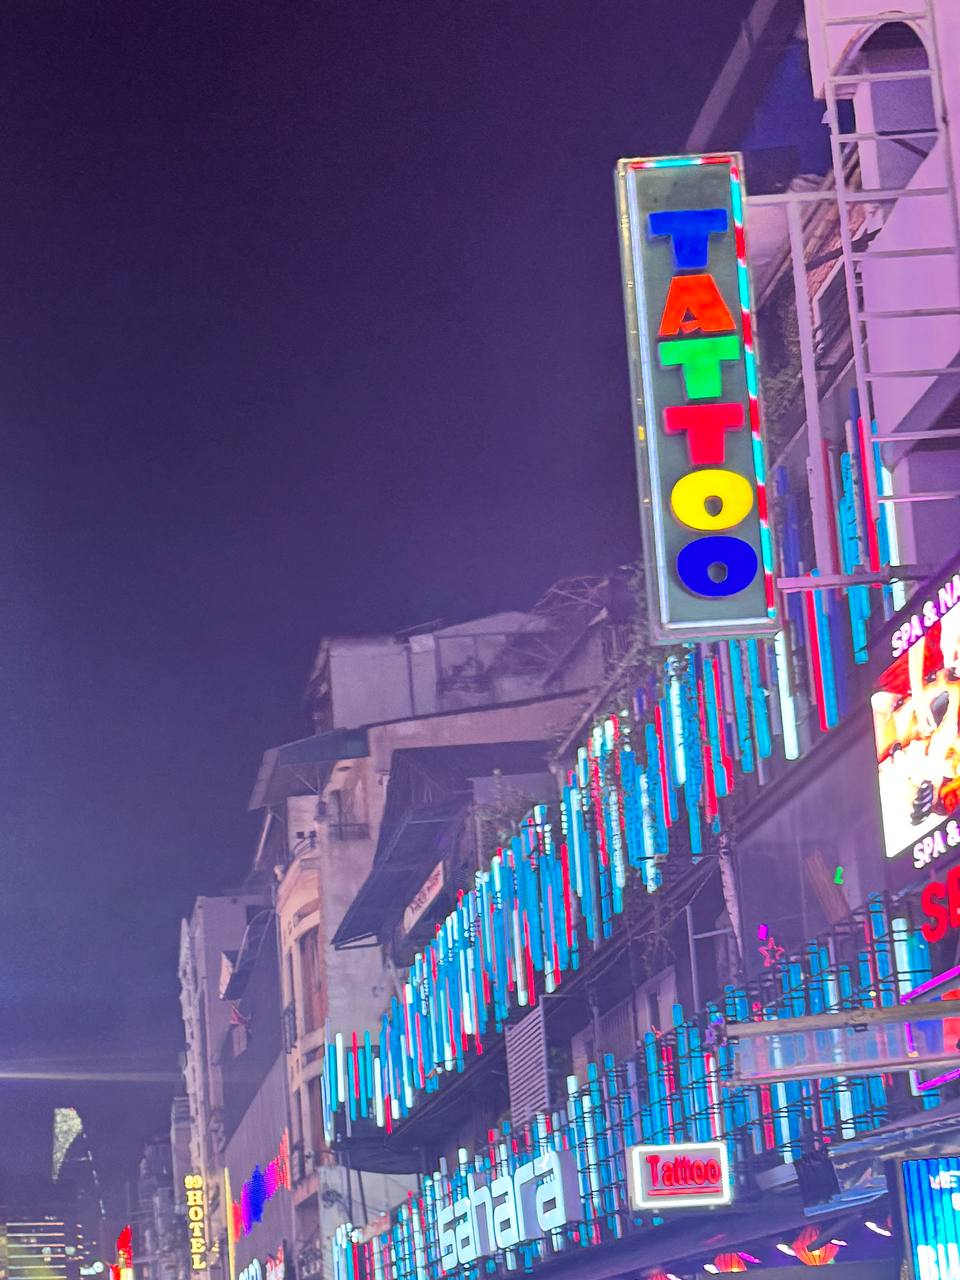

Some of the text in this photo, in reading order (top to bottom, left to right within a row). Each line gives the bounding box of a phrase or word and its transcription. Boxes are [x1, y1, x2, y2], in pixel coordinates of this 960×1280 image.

[648, 208, 758, 598] TATTOO
[892, 614, 923, 658] SPA
[913, 830, 946, 868] SPA
[646, 1155, 722, 1188] Tattoo
[186, 1190, 207, 1270] HOTEL
